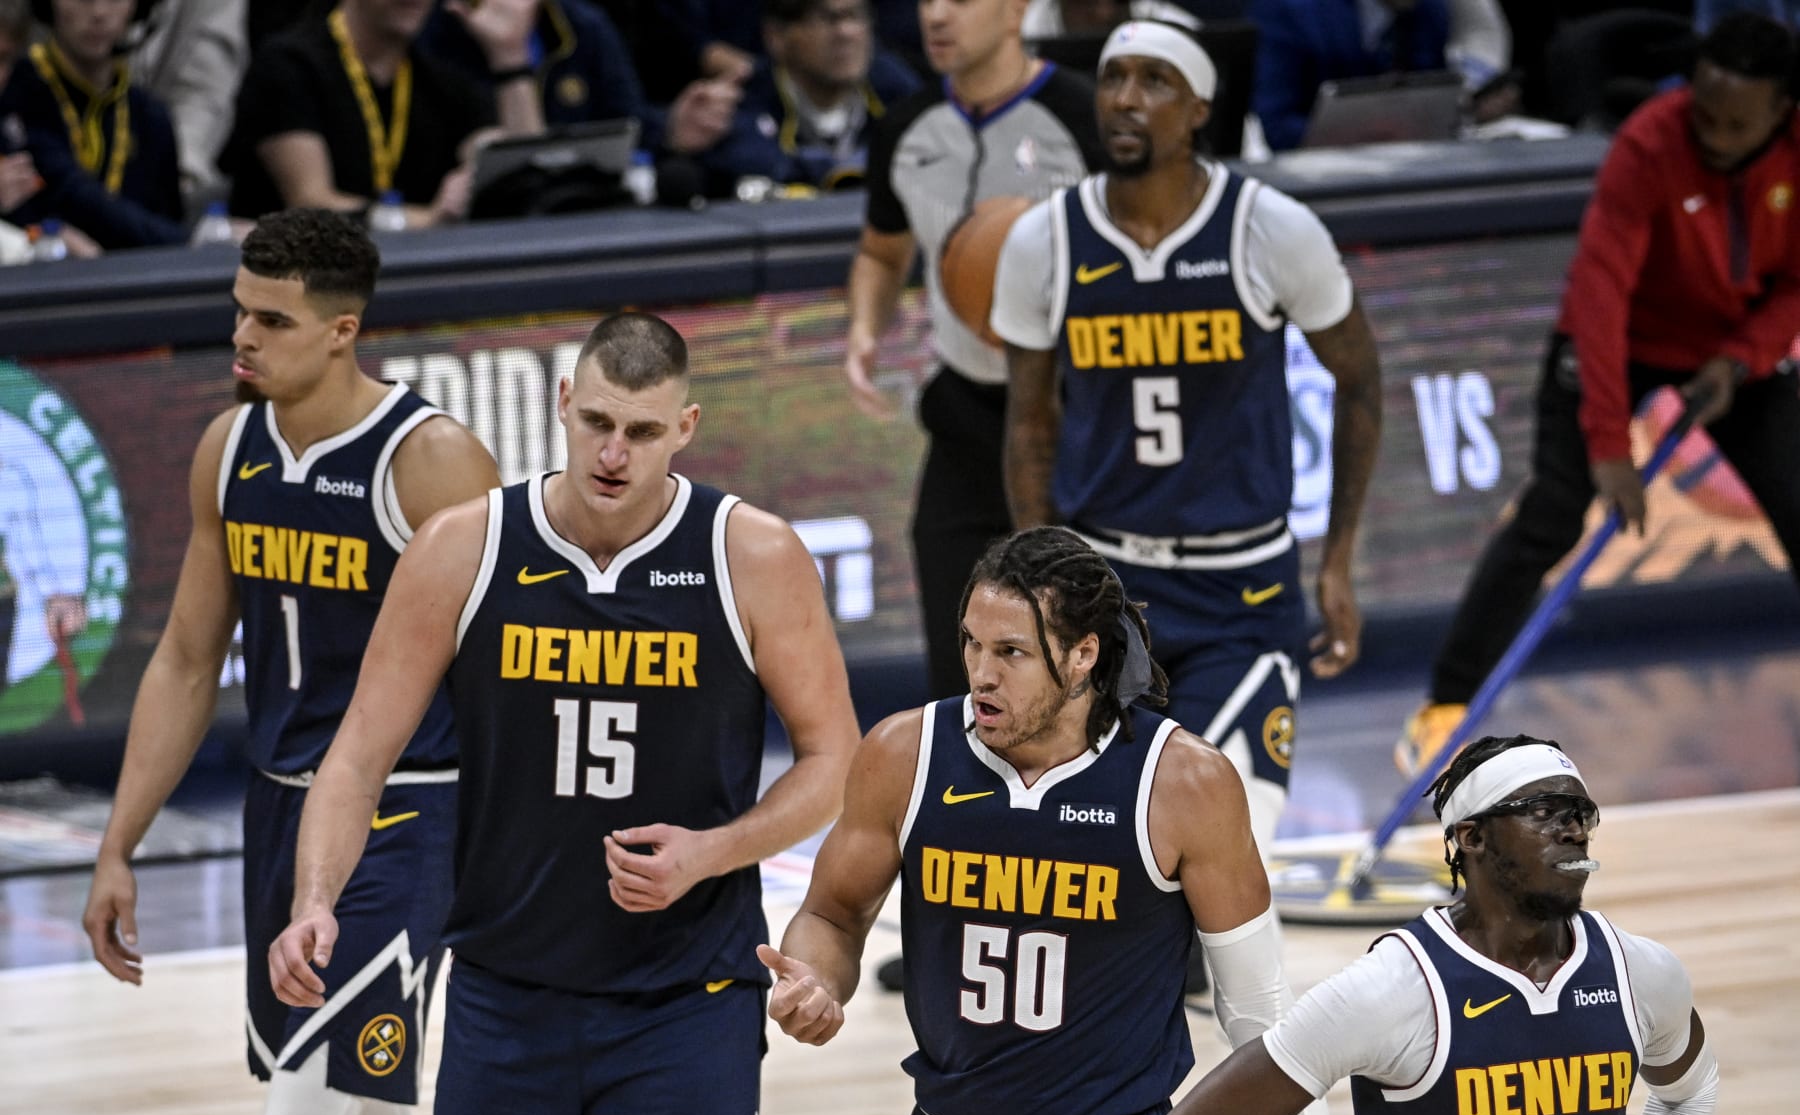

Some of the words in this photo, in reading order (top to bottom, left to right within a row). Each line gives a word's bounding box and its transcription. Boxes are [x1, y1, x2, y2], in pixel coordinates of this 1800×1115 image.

[1176, 260, 1229, 279] ibotta
[1066, 309, 1244, 369] DENVER
[1133, 377, 1183, 467] 5
[1411, 370, 1503, 494] VS
[315, 475, 365, 498] ibotta
[225, 520, 369, 591] DENVER
[650, 570, 706, 587] ibotta
[281, 594, 302, 690] 1
[501, 623, 698, 687] DENVER
[554, 698, 638, 799] 15
[1060, 805, 1116, 825] ibotta
[922, 846, 1120, 921] DENVER
[960, 921, 1069, 1032] 50
[1574, 988, 1618, 1007] ibotta
